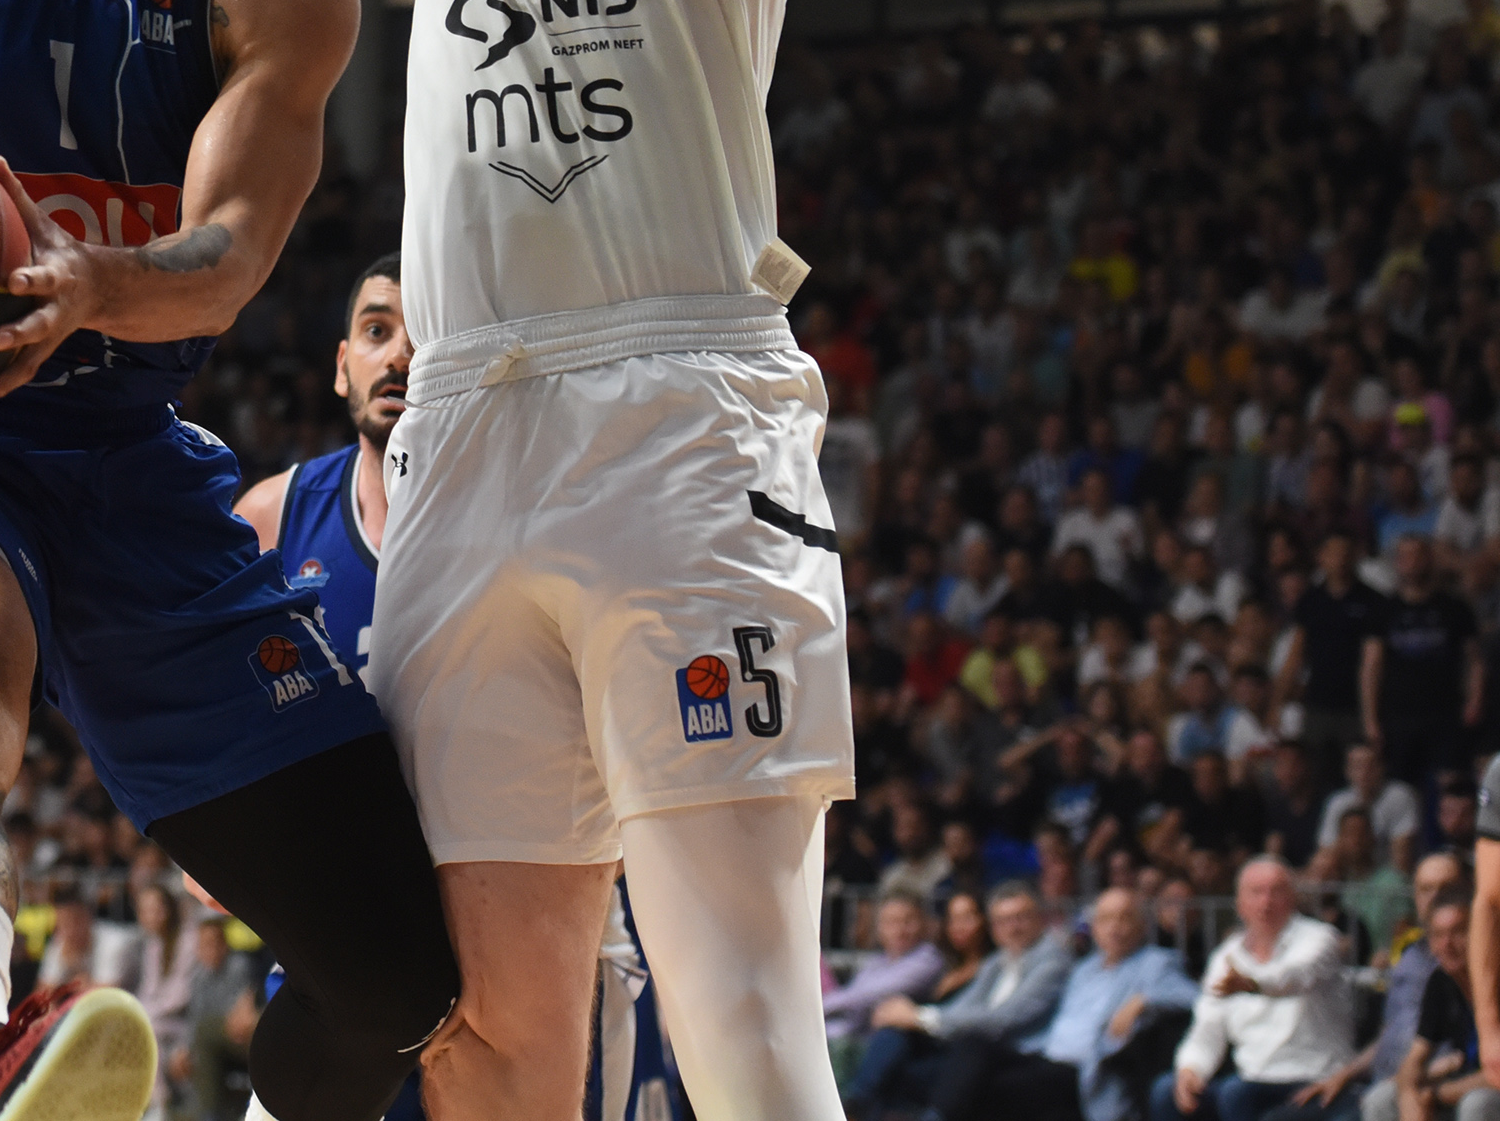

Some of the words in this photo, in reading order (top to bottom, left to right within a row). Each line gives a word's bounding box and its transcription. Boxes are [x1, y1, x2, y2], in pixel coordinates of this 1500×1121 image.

[141, 9, 175, 46] ABA
[551, 40, 610, 56] GAZPROM
[613, 37, 644, 51] NEFT
[50, 39, 78, 150] 1
[465, 67, 634, 153] mts
[272, 670, 314, 706] ABA
[687, 702, 730, 736] ABA
[733, 626, 782, 738] 5
